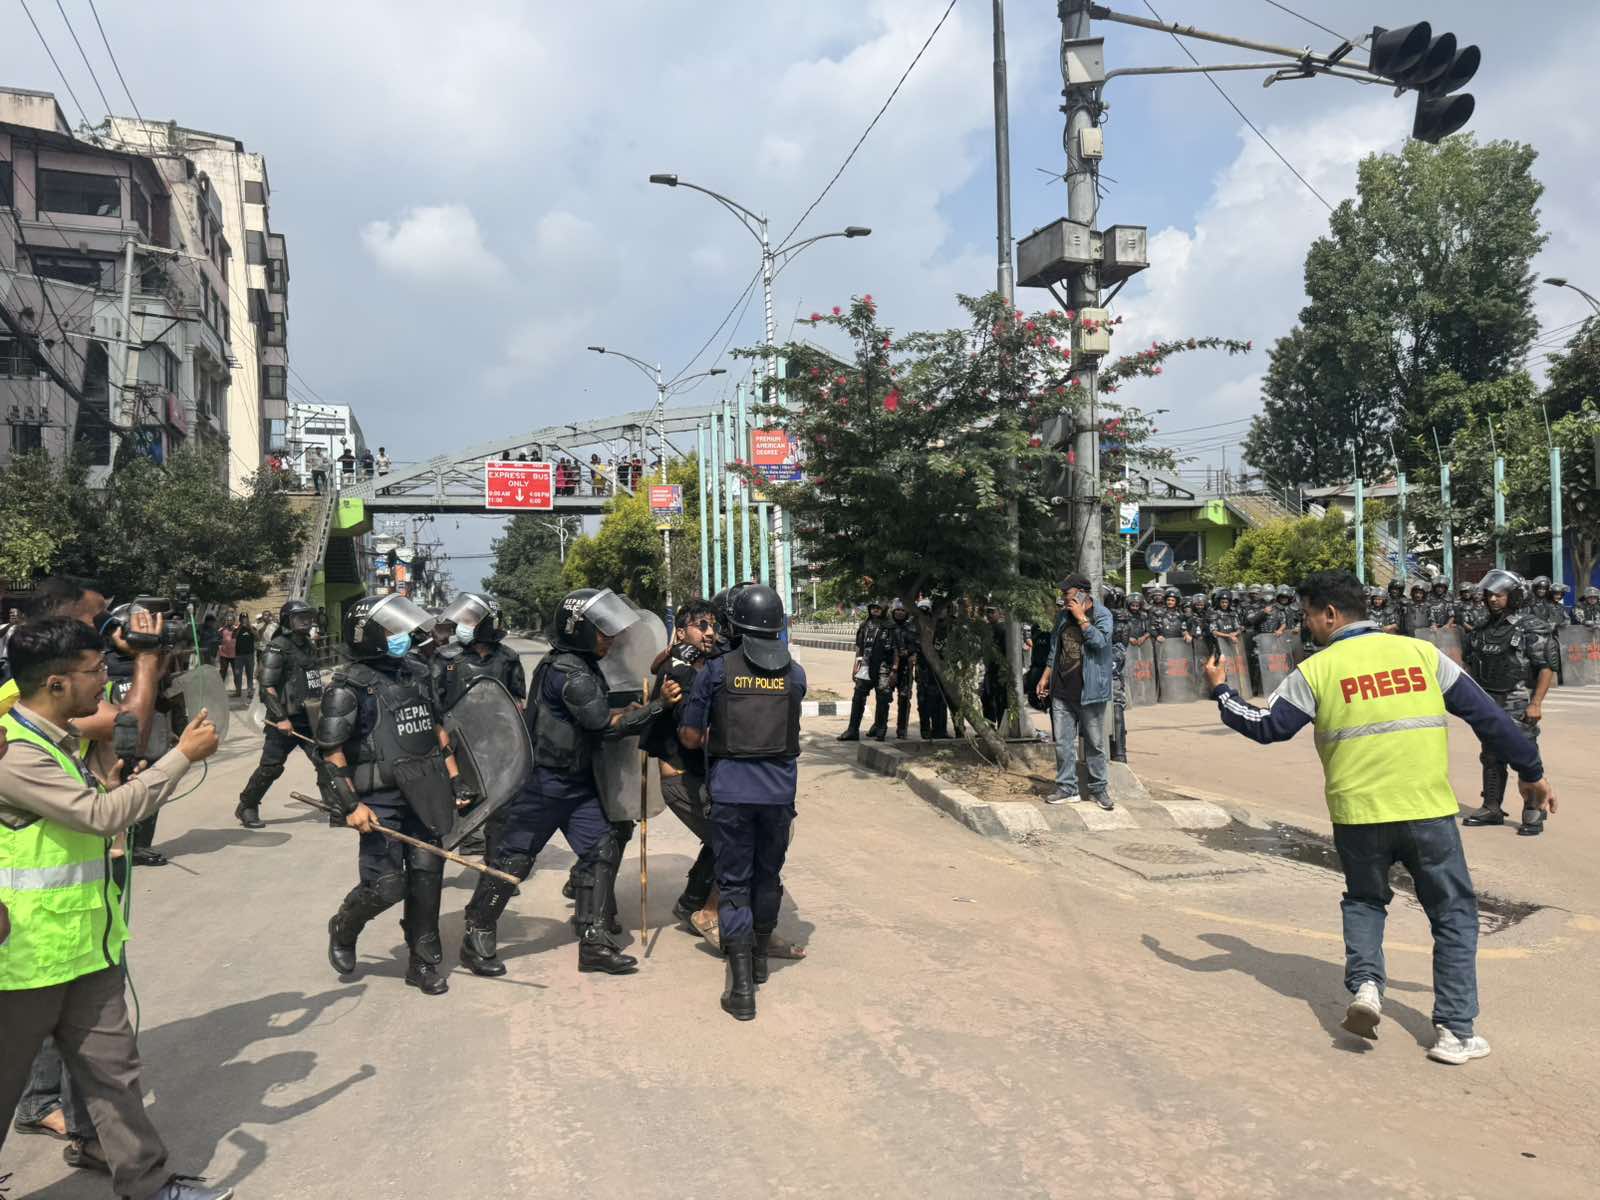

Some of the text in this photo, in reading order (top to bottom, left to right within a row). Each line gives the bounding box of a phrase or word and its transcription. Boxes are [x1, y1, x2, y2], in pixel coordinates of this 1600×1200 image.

[734, 676, 785, 690] CITY POLICE
[1340, 667, 1427, 704] PRESS
[396, 704, 430, 722] NEPAL
[397, 718, 432, 736] POLICE
